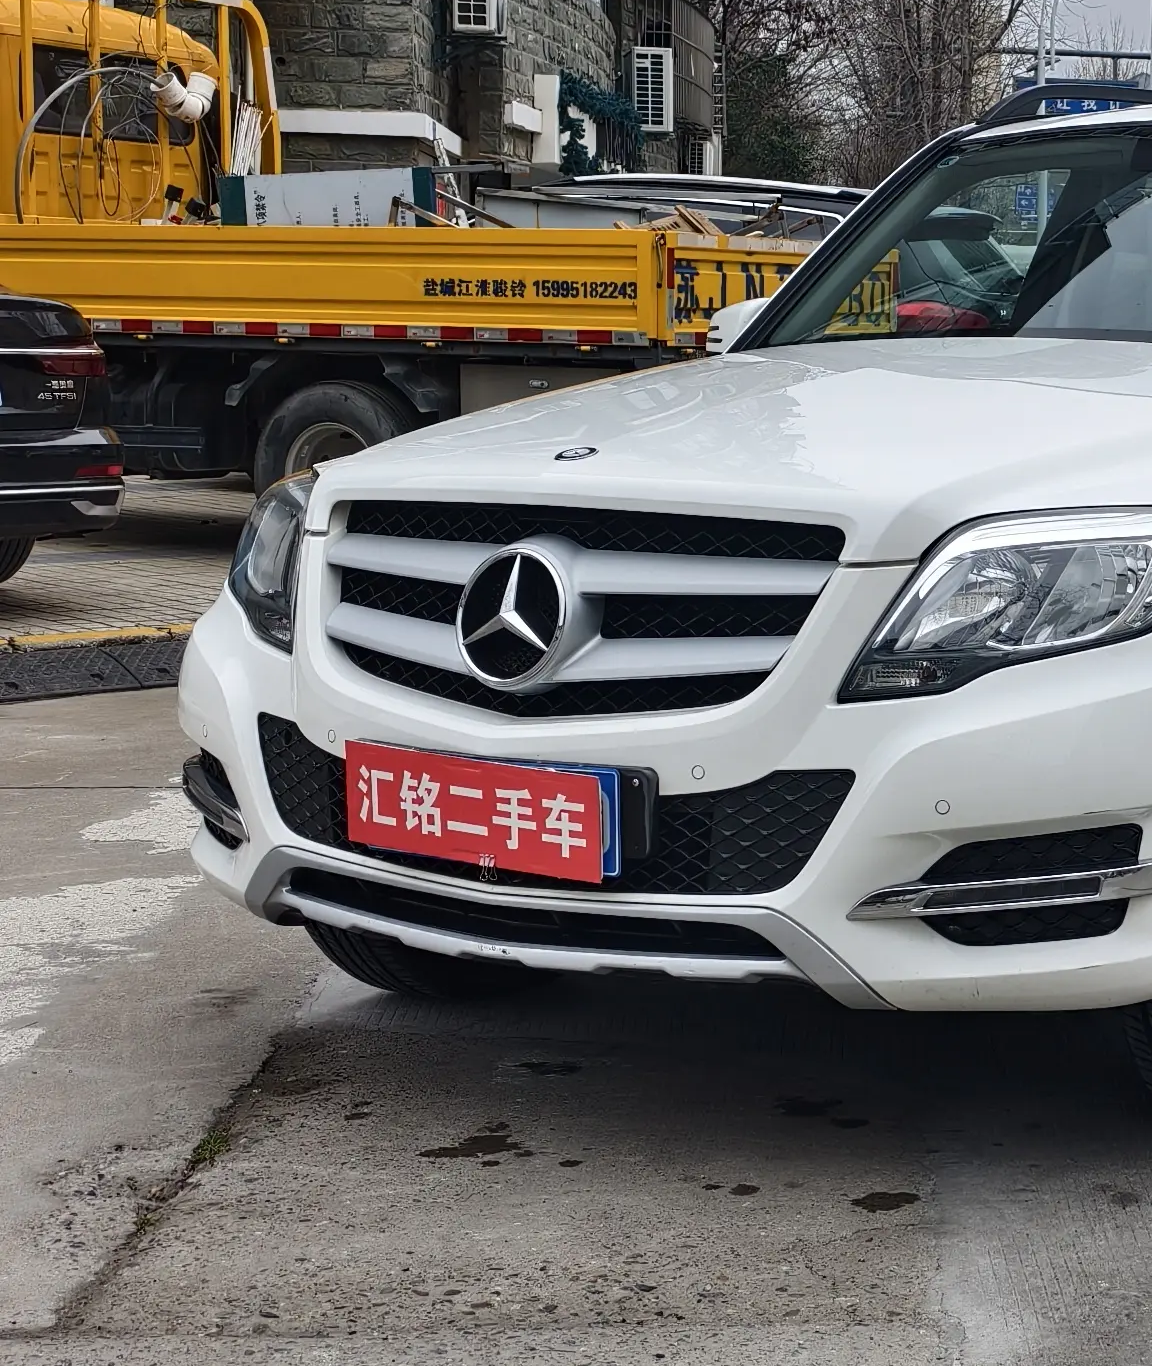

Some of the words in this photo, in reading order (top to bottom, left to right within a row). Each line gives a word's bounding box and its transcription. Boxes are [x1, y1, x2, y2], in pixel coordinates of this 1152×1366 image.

[532, 279, 638, 300] 15995182243
[358, 764, 587, 858] 汇铭二手车
